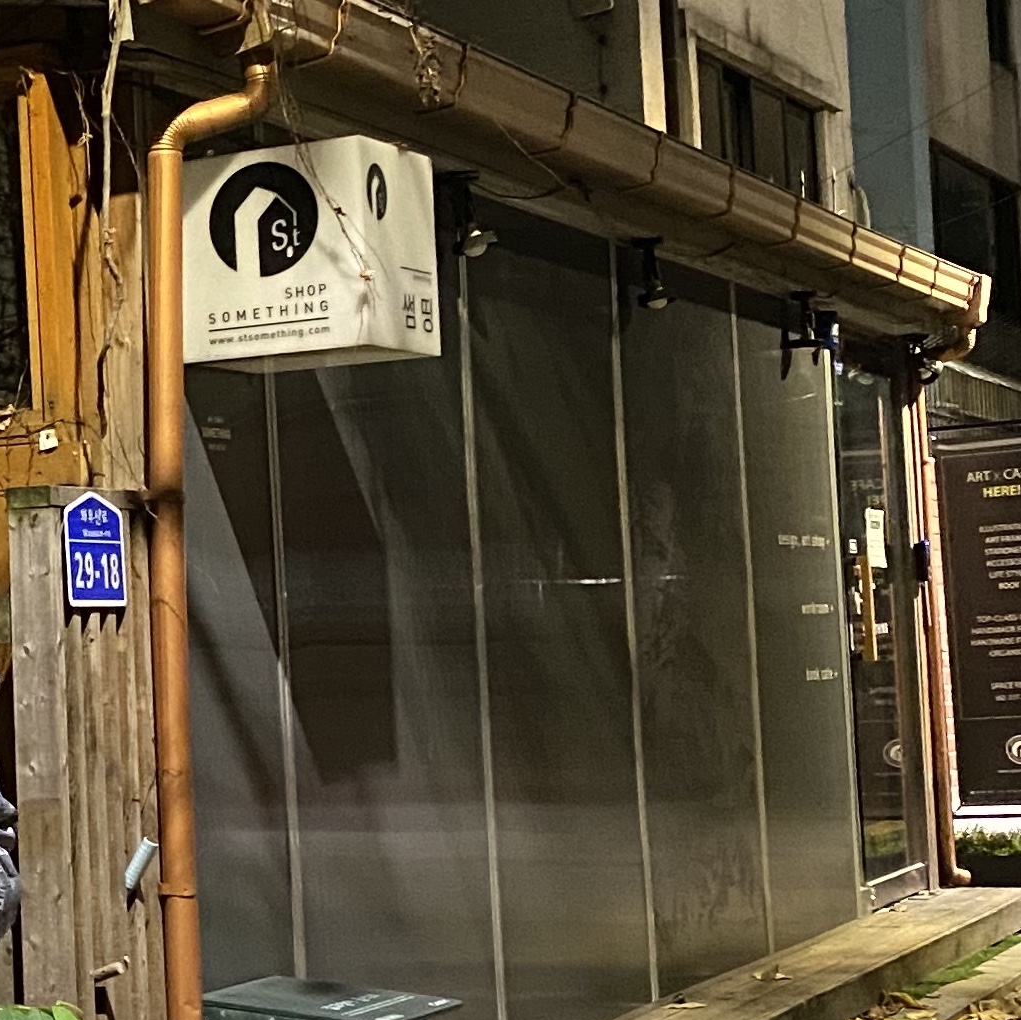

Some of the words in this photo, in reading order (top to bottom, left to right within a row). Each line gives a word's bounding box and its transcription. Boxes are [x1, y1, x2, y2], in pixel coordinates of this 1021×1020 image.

[285, 284, 328, 299] SHOP
[209, 300, 330, 325] SOMETHING
[209, 326, 331, 345] www.stsomething.com
[967, 470, 991, 483] ART
[74, 551, 121, 590] 29-18
